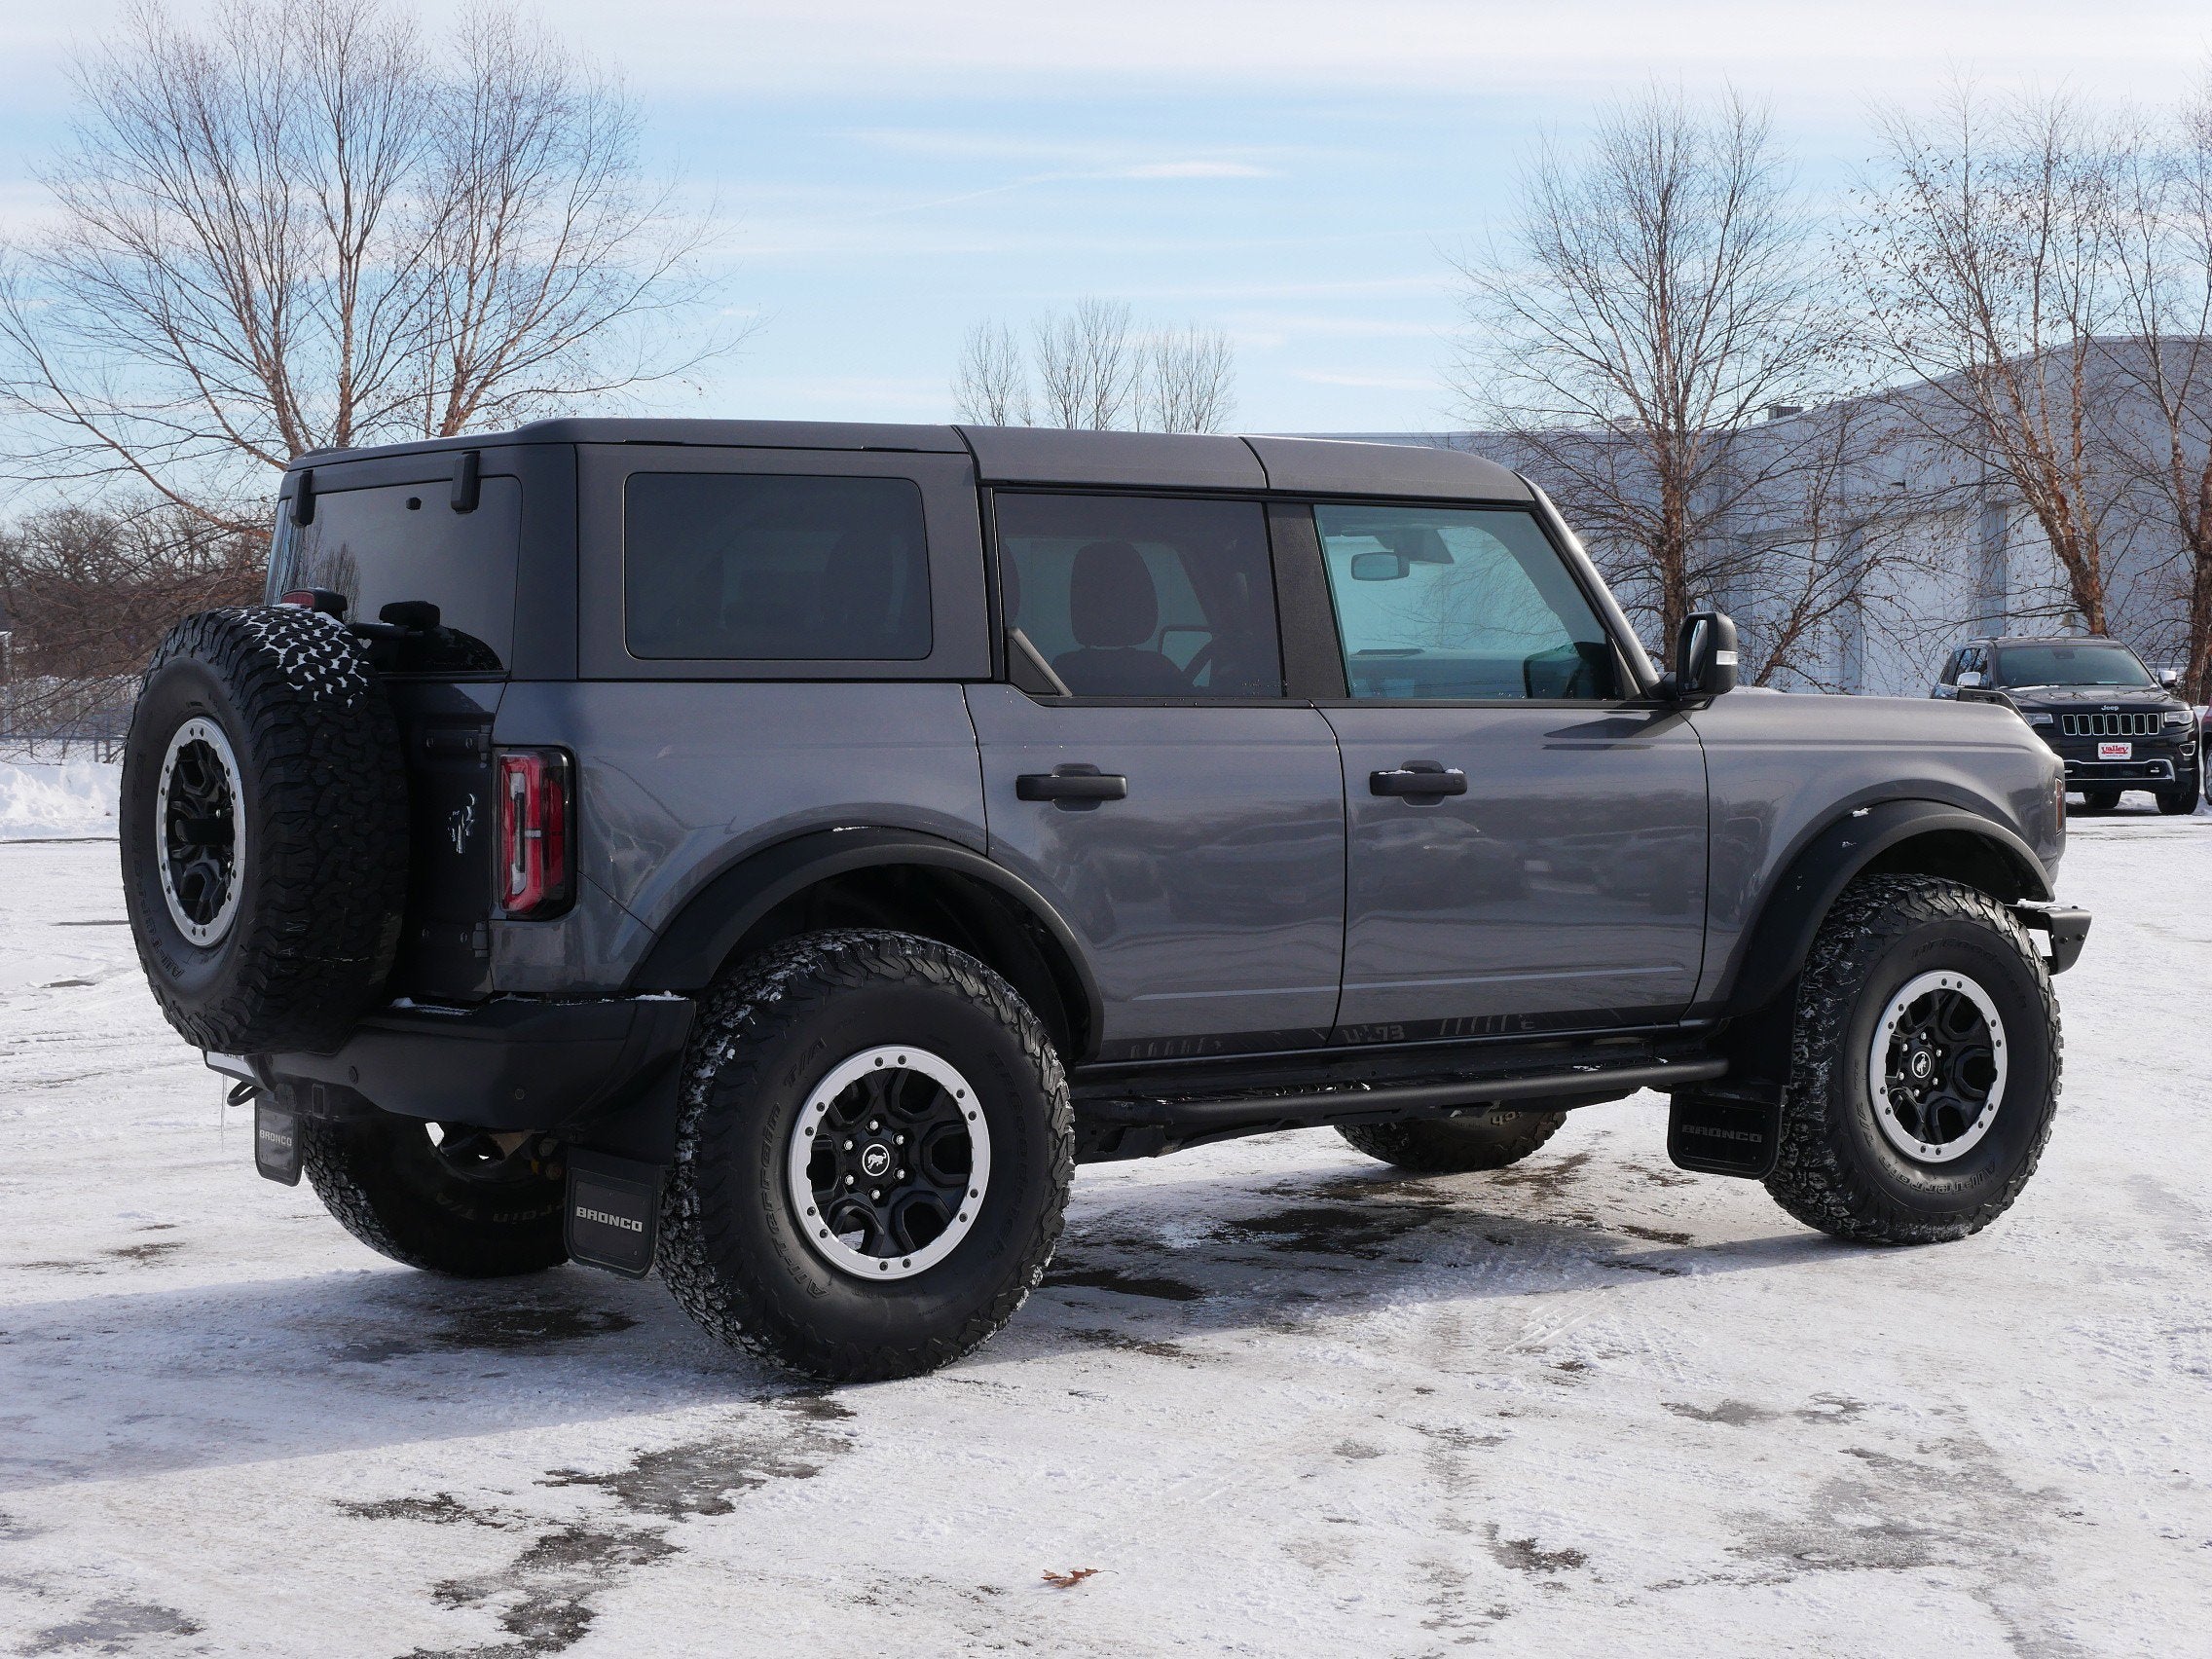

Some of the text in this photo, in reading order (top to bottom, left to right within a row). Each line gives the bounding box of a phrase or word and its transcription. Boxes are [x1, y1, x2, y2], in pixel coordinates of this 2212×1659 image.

[258, 1128, 293, 1147] BRONCO
[1680, 1124, 1763, 1144] BRONCO
[760, 1102, 830, 1300] All-Terrain
[574, 1204, 644, 1234] BRONCO
